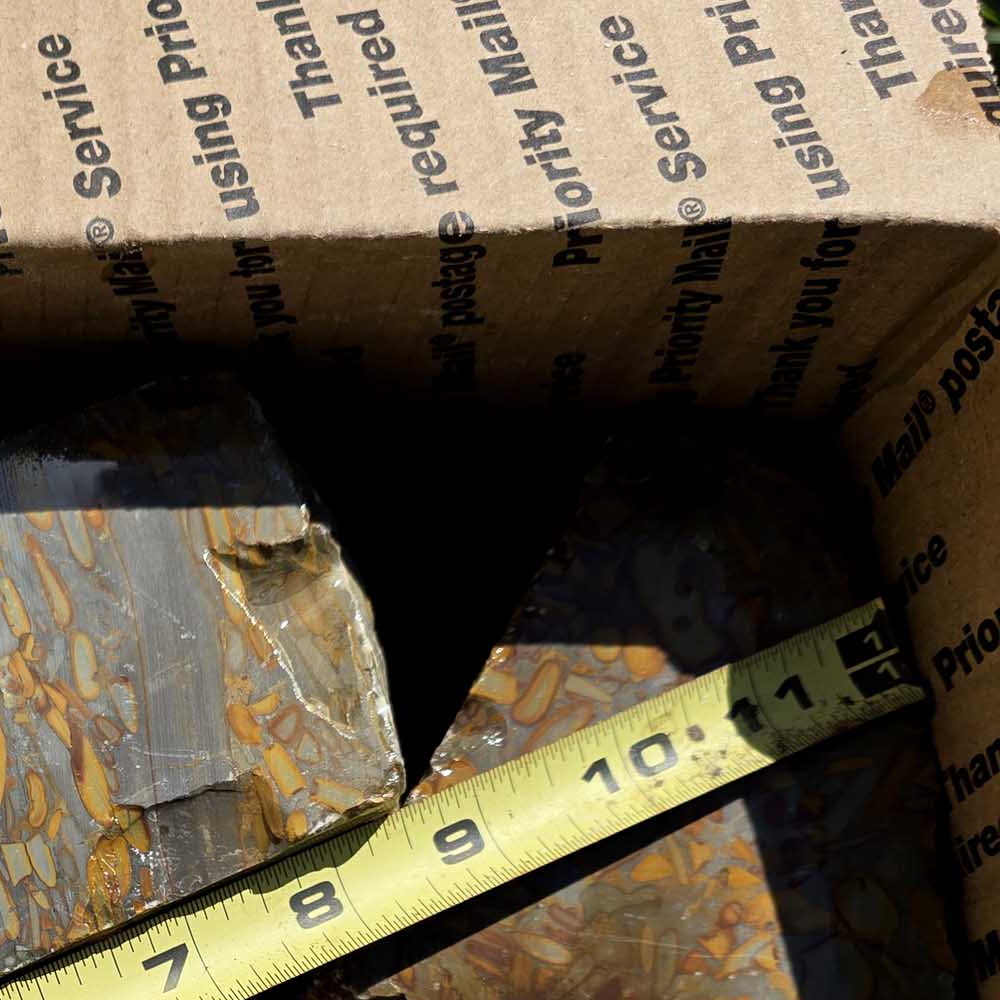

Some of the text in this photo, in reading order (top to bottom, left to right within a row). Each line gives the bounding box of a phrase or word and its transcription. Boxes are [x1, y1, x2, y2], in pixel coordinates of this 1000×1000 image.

[37, 33, 122, 200] Service
[183, 93, 260, 221] using
[336, 9, 459, 196] required
[600, 14, 707, 183] Service
[754, 74, 850, 200] using
[513, 108, 604, 268] Priority
[800, 218, 862, 270] for
[932, 607, 1000, 692] Prio
[141, 942, 190, 994] 7
[288, 880, 344, 930] 8
[431, 817, 487, 865] 9
[581, 731, 679, 795] 10
[729, 674, 814, 733] 11
